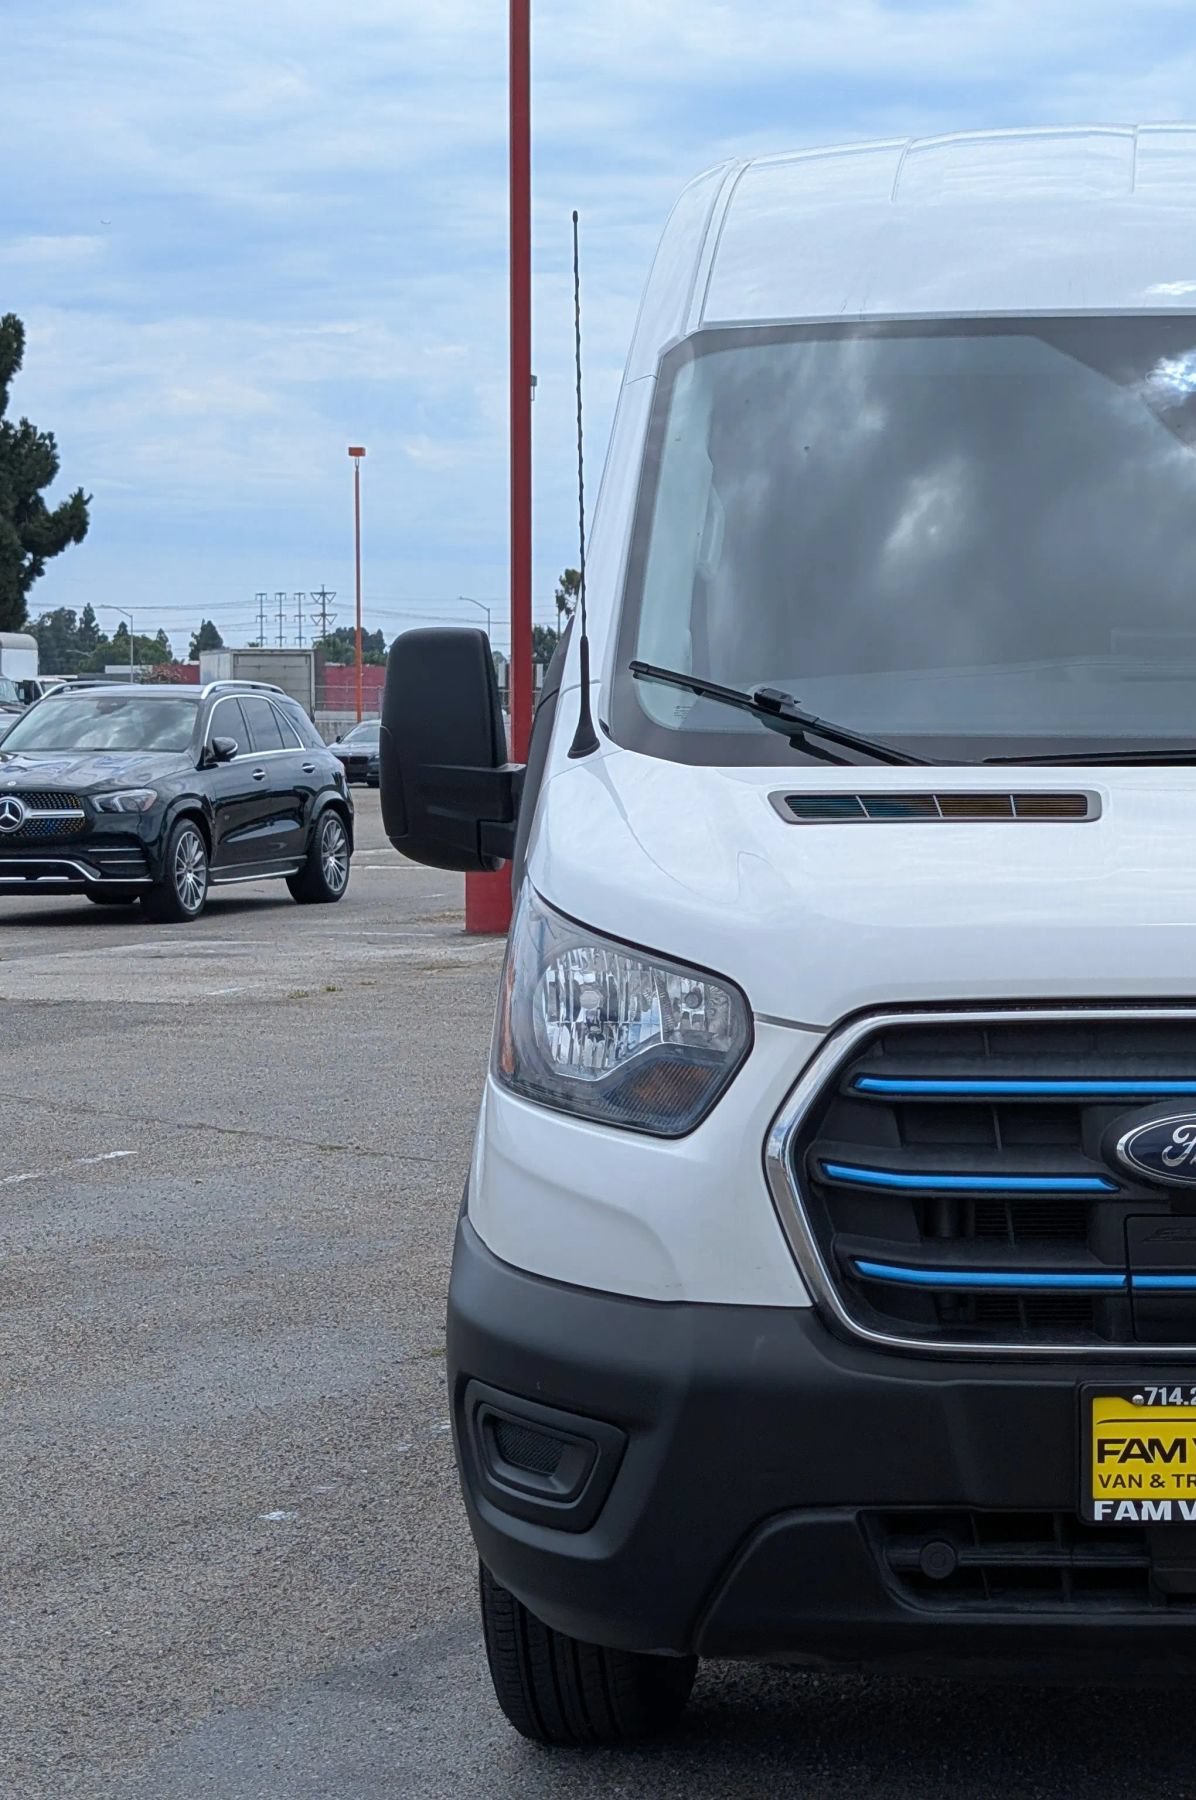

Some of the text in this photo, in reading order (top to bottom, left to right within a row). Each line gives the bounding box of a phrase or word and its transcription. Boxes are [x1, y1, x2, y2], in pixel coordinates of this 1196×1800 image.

[1097, 1437, 1187, 1464] FAM
[1098, 1473, 1143, 1489] VAN
[1149, 1473, 1166, 1489] &
[1094, 1500, 1172, 1521] FAM
